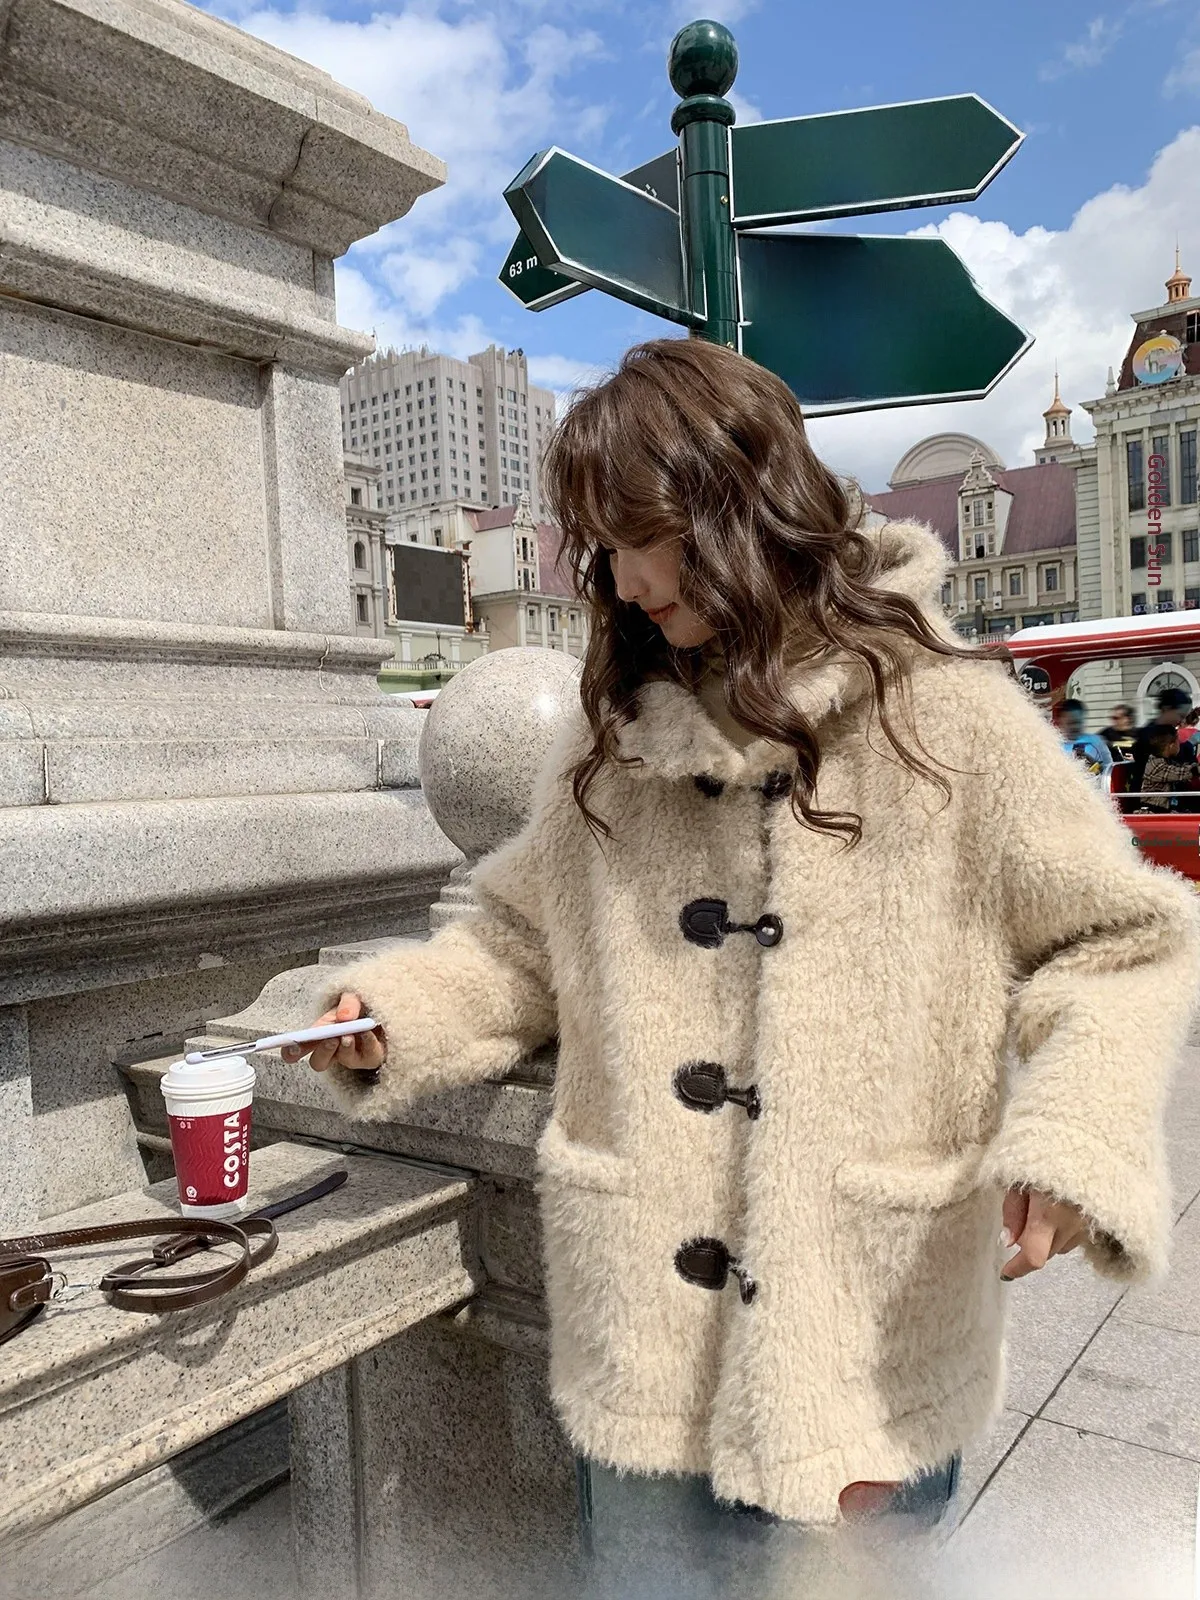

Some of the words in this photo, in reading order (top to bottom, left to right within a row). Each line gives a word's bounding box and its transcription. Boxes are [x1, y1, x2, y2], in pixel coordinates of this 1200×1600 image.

[510, 261, 522, 278] 63
[526, 255, 538, 270] m
[1148, 454, 1167, 535] Golden
[1148, 544, 1166, 586] Sun
[223, 1111, 241, 1188] COSTA
